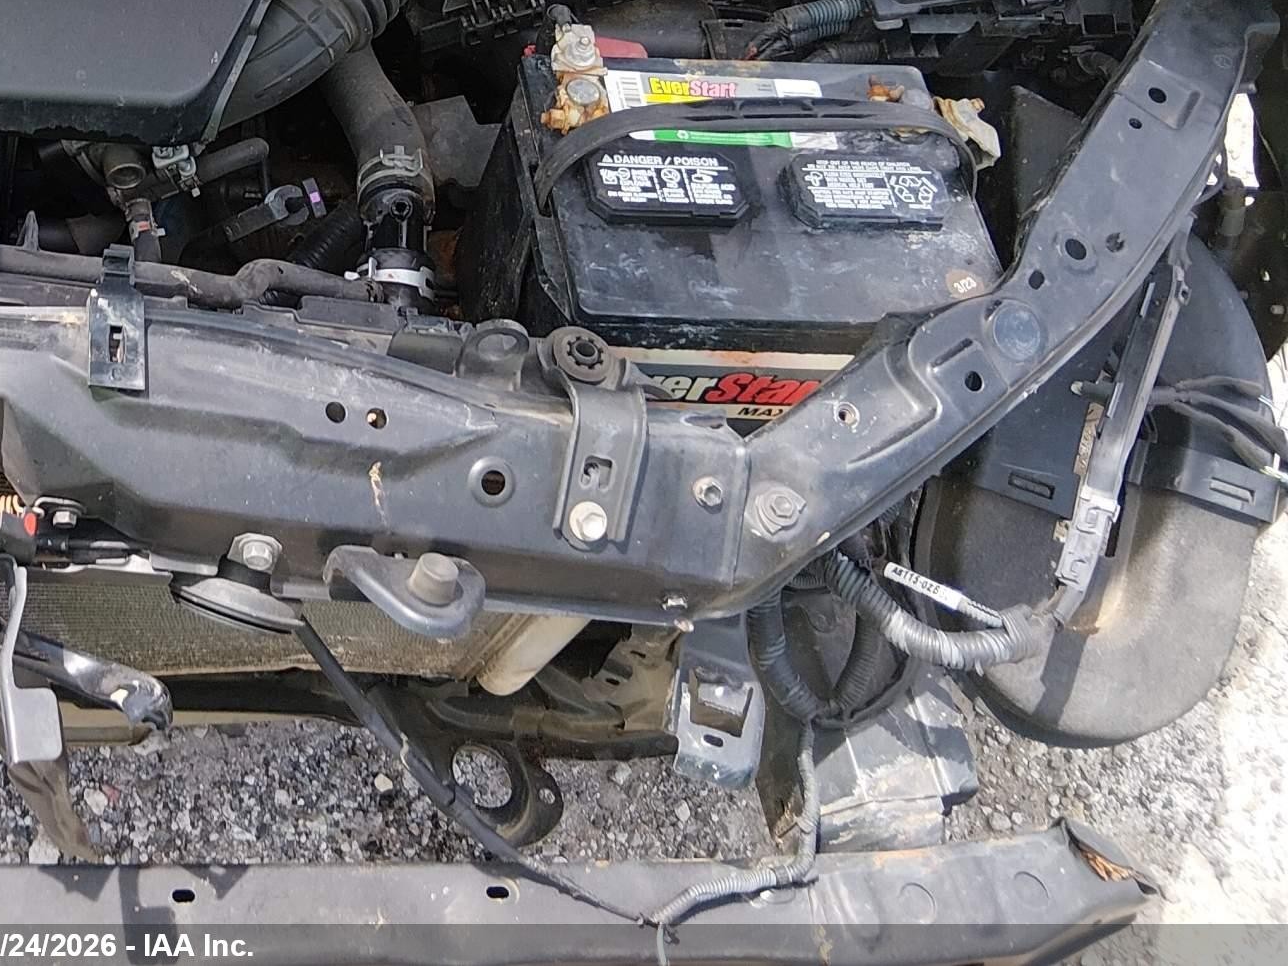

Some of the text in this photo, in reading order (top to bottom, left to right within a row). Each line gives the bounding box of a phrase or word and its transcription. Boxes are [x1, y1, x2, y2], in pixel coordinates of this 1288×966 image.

[648, 76, 737, 99] EverStart
[613, 154, 663, 165] DANGER
[673, 156, 719, 167] POISON
